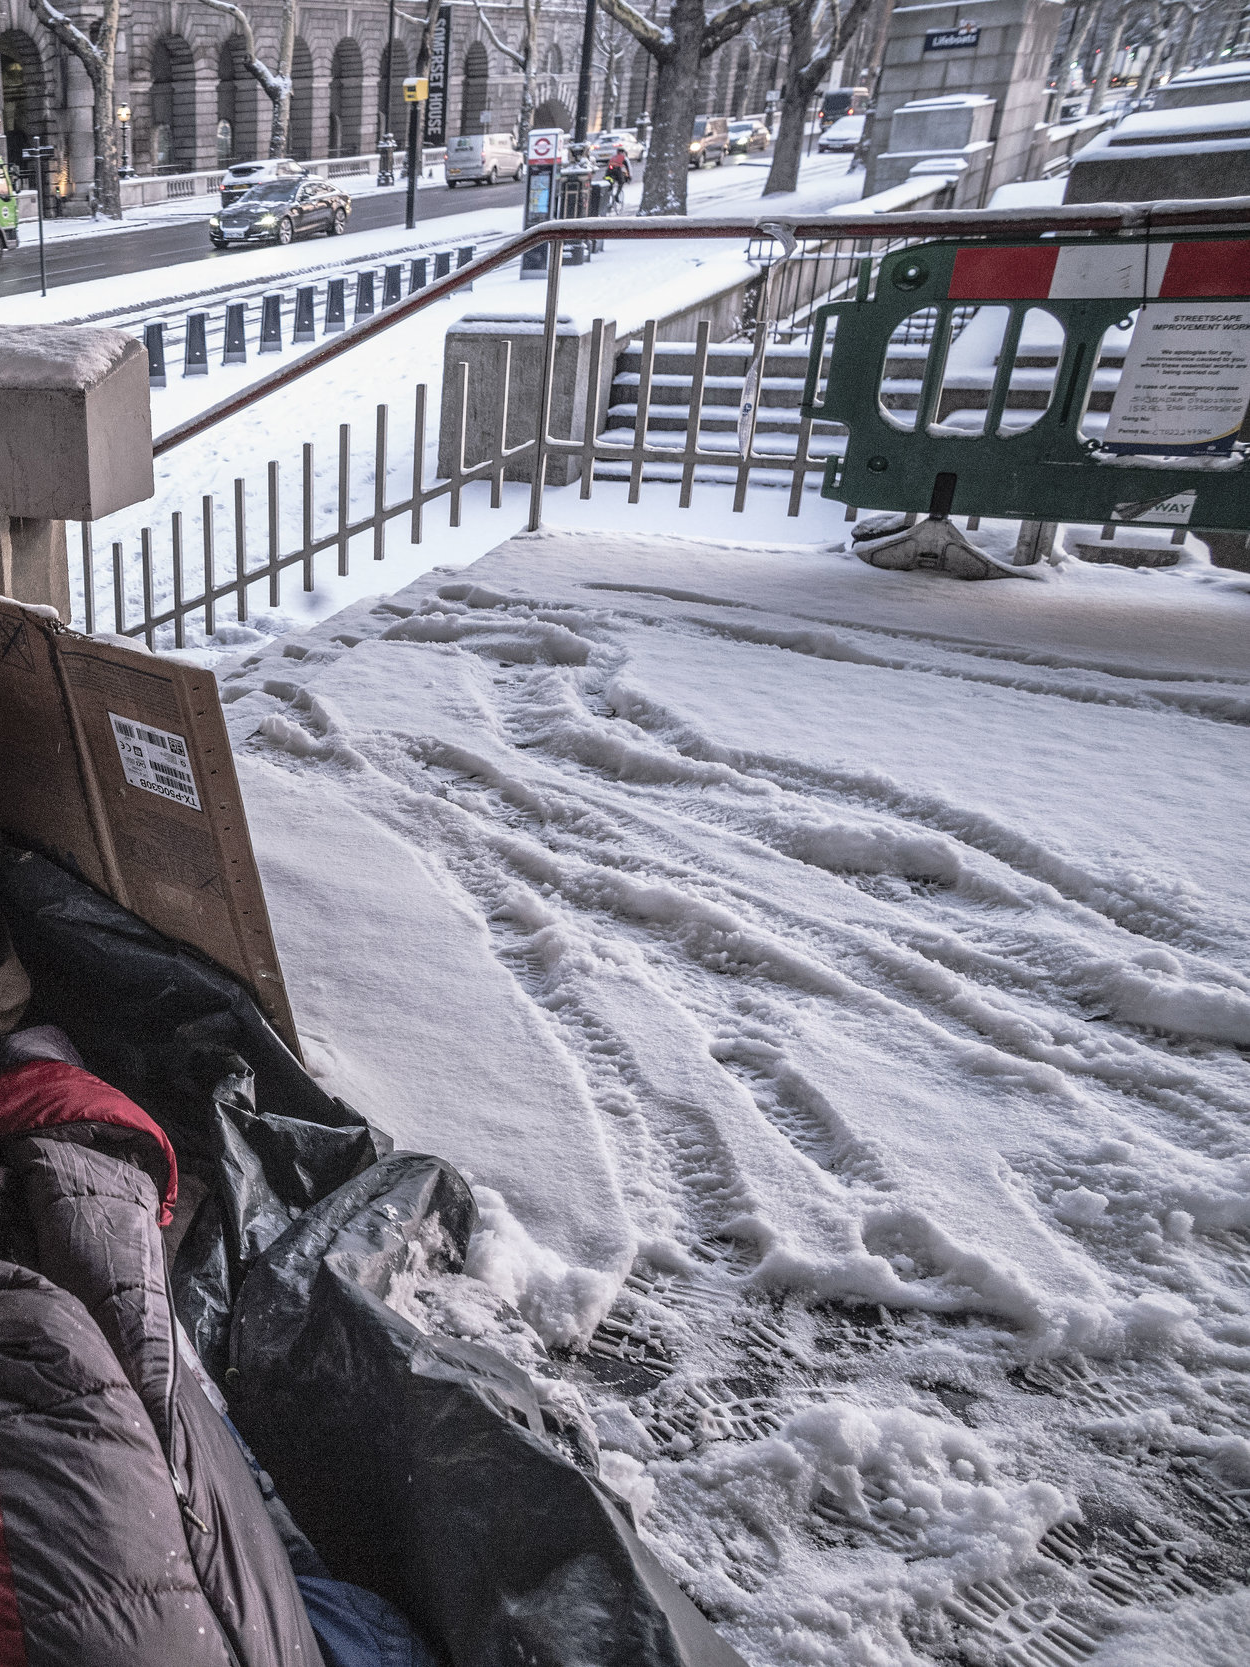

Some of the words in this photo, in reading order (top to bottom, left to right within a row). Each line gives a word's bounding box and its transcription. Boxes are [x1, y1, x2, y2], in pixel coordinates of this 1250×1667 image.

[931, 34, 977, 47] Lifeboats
[429, 17, 447, 89] SOMERSET
[427, 92, 443, 135] HOUSE
[1152, 323, 1221, 331] IMPROVEMENT
[1174, 314, 1243, 322] STREETSCAPE
[138, 778, 199, 807] TX-P50G30B
